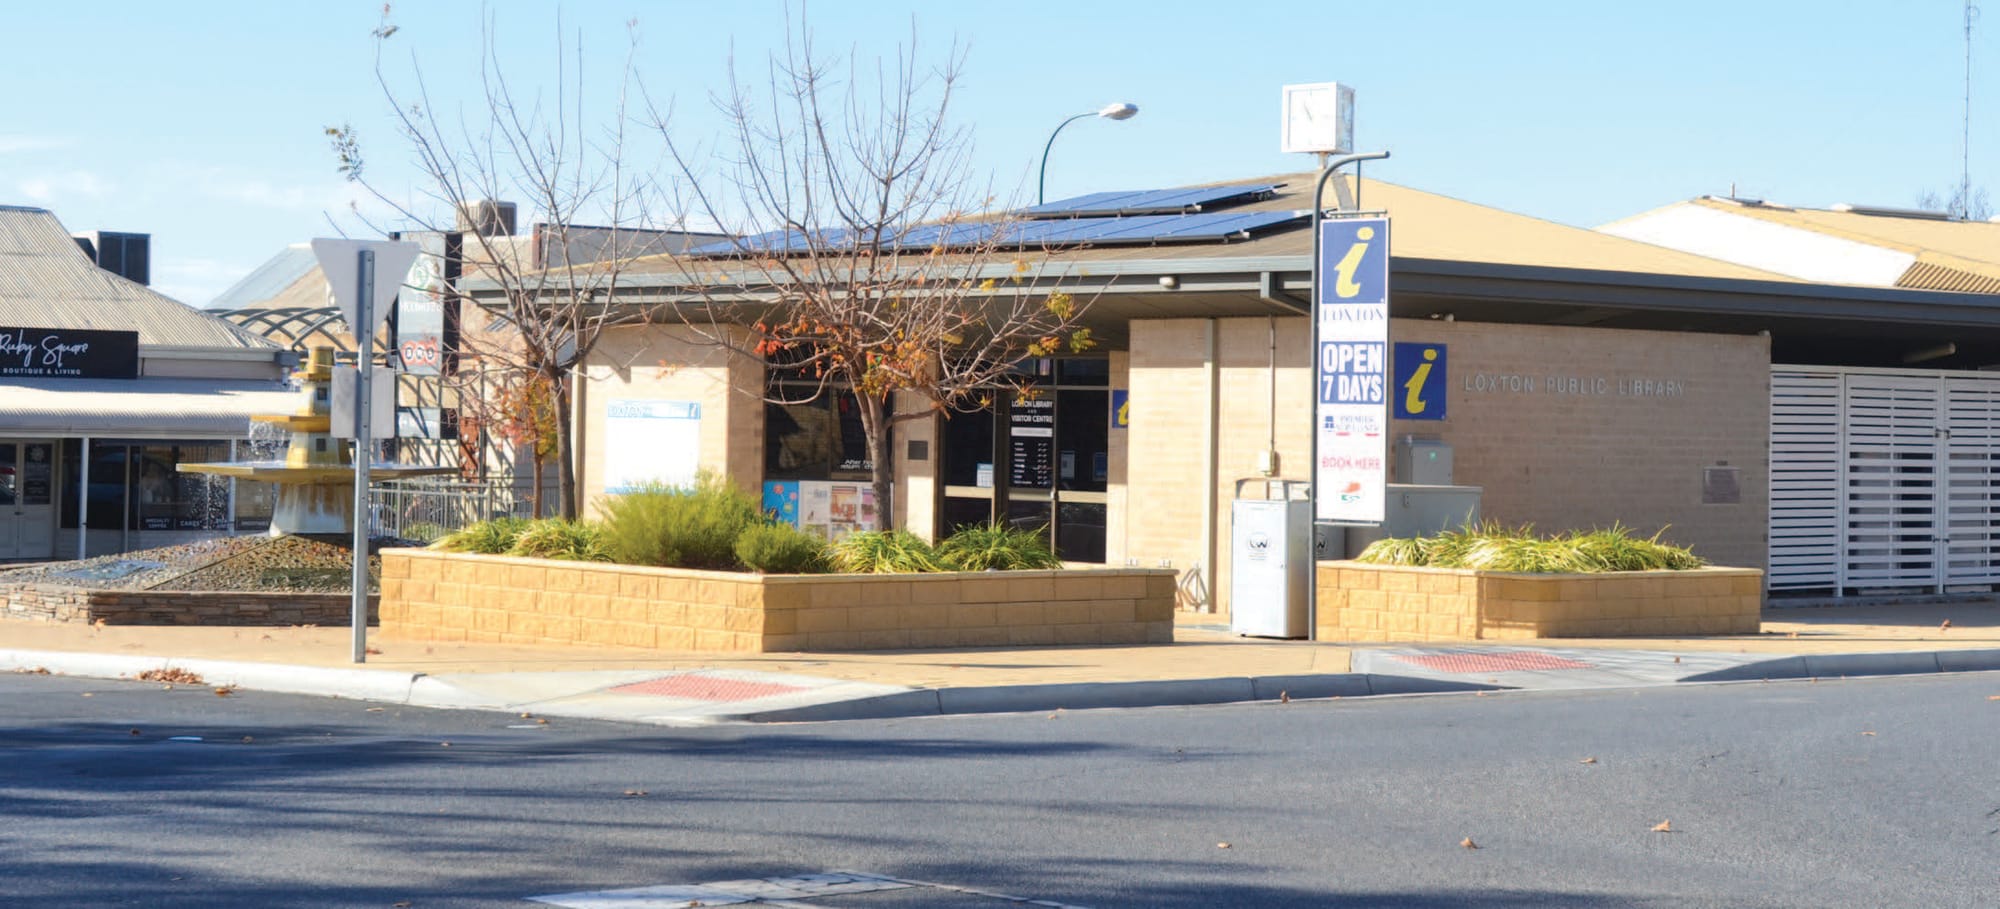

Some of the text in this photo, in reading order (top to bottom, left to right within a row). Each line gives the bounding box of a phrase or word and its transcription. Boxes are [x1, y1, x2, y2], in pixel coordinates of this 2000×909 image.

[0, 329, 89, 368] Ruby Square
[1323, 343, 1383, 373] OPEN
[1323, 375, 1383, 402] 7 DAYS
[1463, 373, 1686, 397] LOXTON PUBLIC LIBRARY
[1033, 400, 1053, 408] LIBRARY
[1011, 415, 1053, 423] VISITOR CENTRE
[1321, 456, 1381, 470] BOOK HERE
